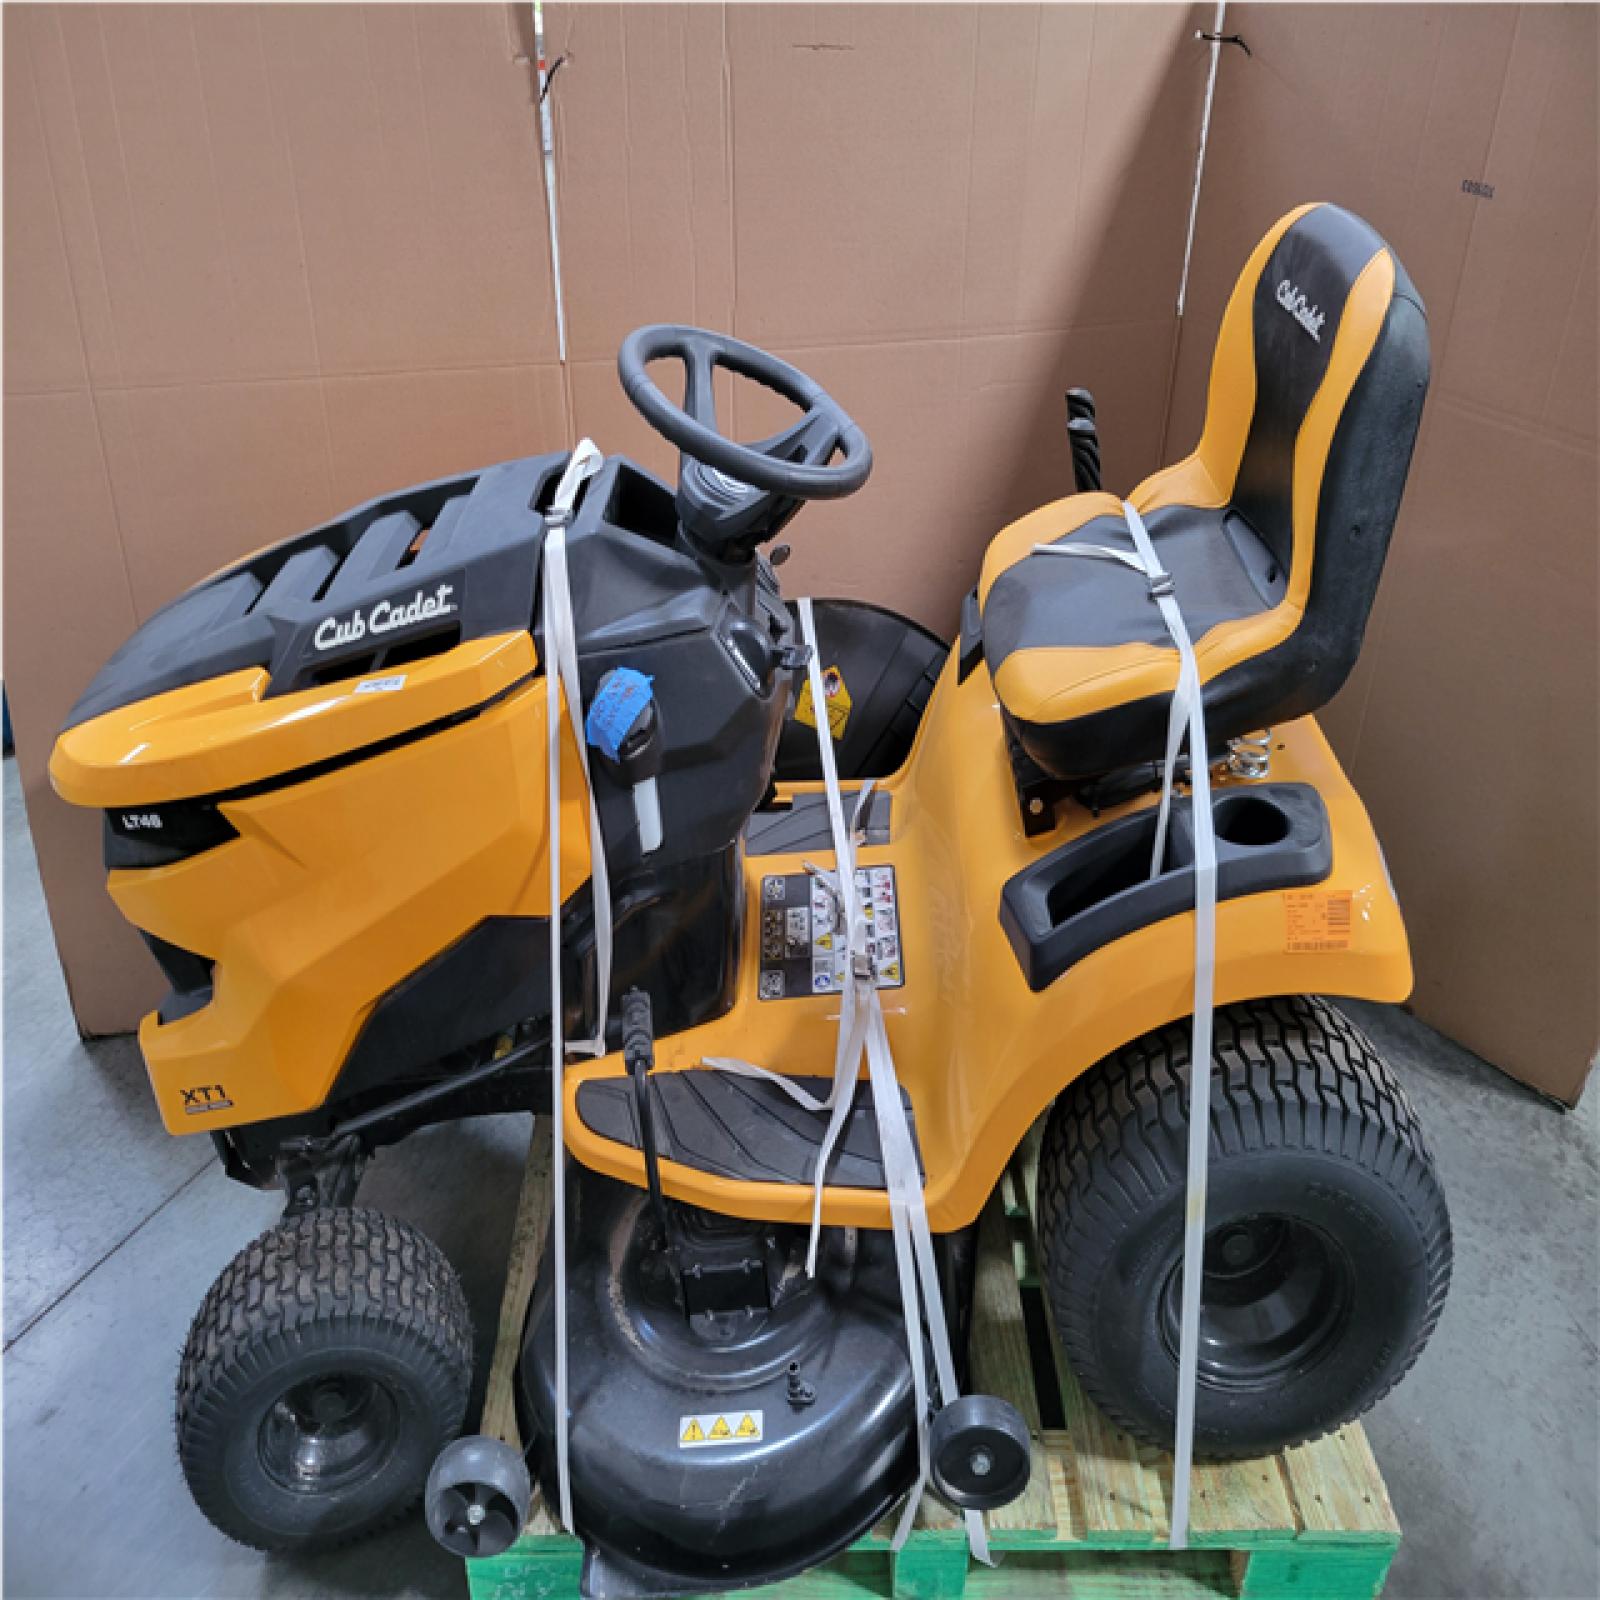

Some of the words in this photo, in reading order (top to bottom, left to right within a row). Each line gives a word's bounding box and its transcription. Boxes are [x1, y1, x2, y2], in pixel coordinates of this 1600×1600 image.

[313, 609, 366, 651] Cub
[369, 584, 454, 634] Cadet
[179, 1084, 226, 1106] XT1
